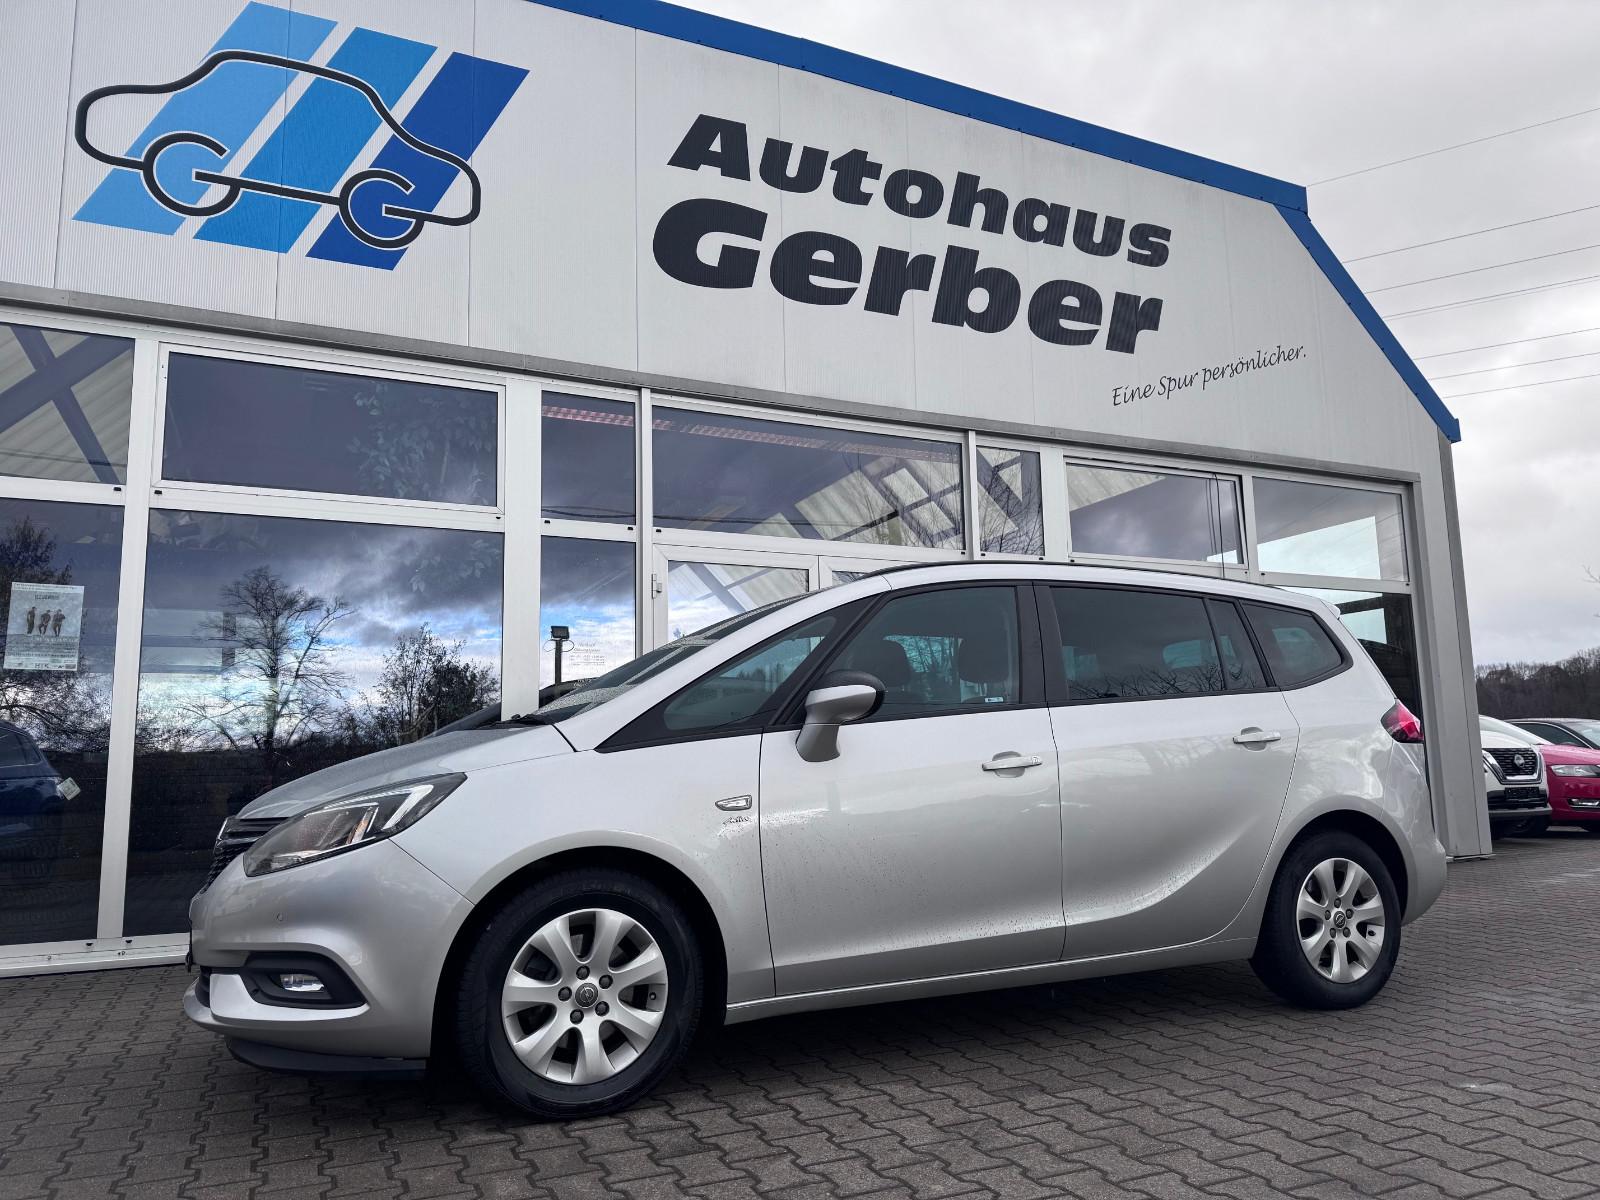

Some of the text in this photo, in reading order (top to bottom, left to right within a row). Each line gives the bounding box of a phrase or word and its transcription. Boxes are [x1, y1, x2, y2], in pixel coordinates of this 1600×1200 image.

[666, 113, 1172, 268] Autohaus
[652, 198, 1164, 355] Gerber
[1112, 345, 1307, 407] Eine Spur persönlicher.
